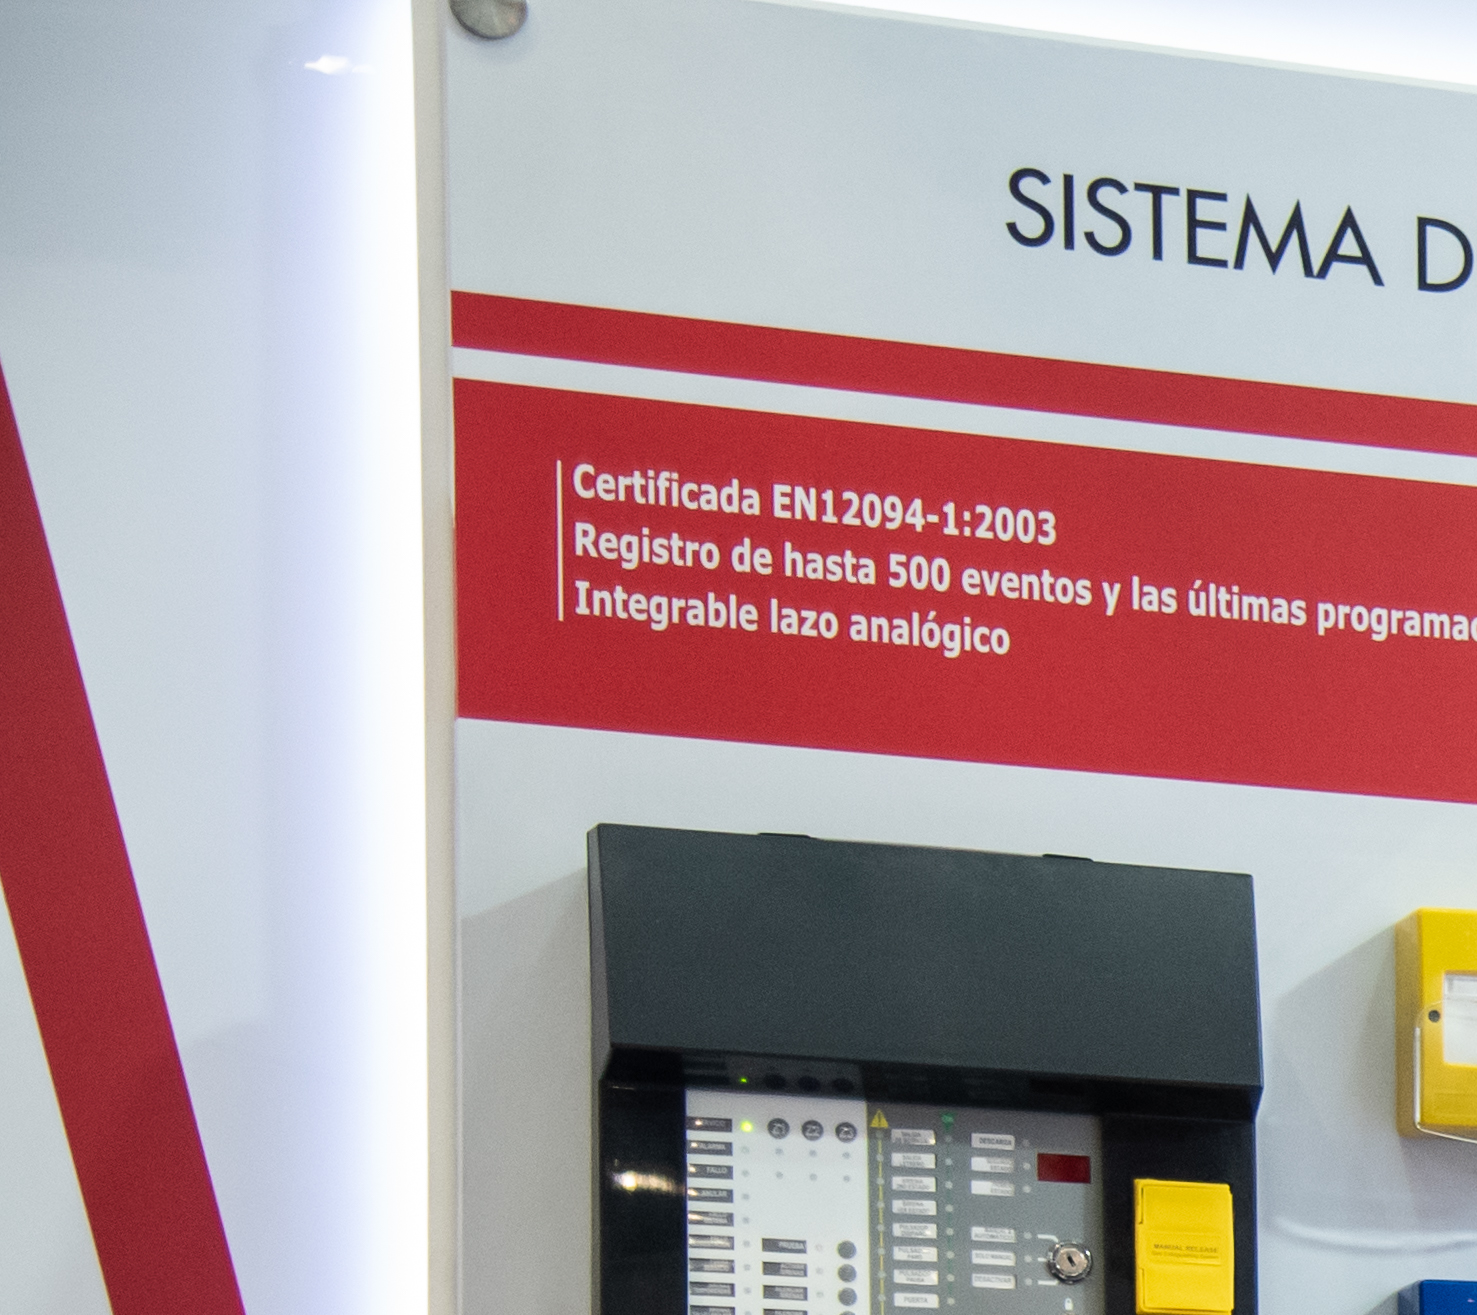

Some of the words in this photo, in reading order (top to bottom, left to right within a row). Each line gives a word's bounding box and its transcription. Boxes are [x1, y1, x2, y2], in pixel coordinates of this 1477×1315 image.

[1005, 167, 1385, 287] SISTEMA
[573, 462, 761, 516] Certificada
[773, 483, 1057, 546] EN12094-1:2003
[574, 521, 721, 571] Registro
[731, 537, 773, 576] de
[784, 541, 877, 585] hasta
[888, 553, 951, 593] 500
[961, 567, 1093, 606] eventos
[1101, 581, 1122, 617] y
[1131, 575, 1178, 614] las
[1188, 579, 1308, 627] últimas
[575, 580, 759, 632] Integrable
[770, 597, 839, 640] lazo
[849, 610, 1011, 659] analógico
